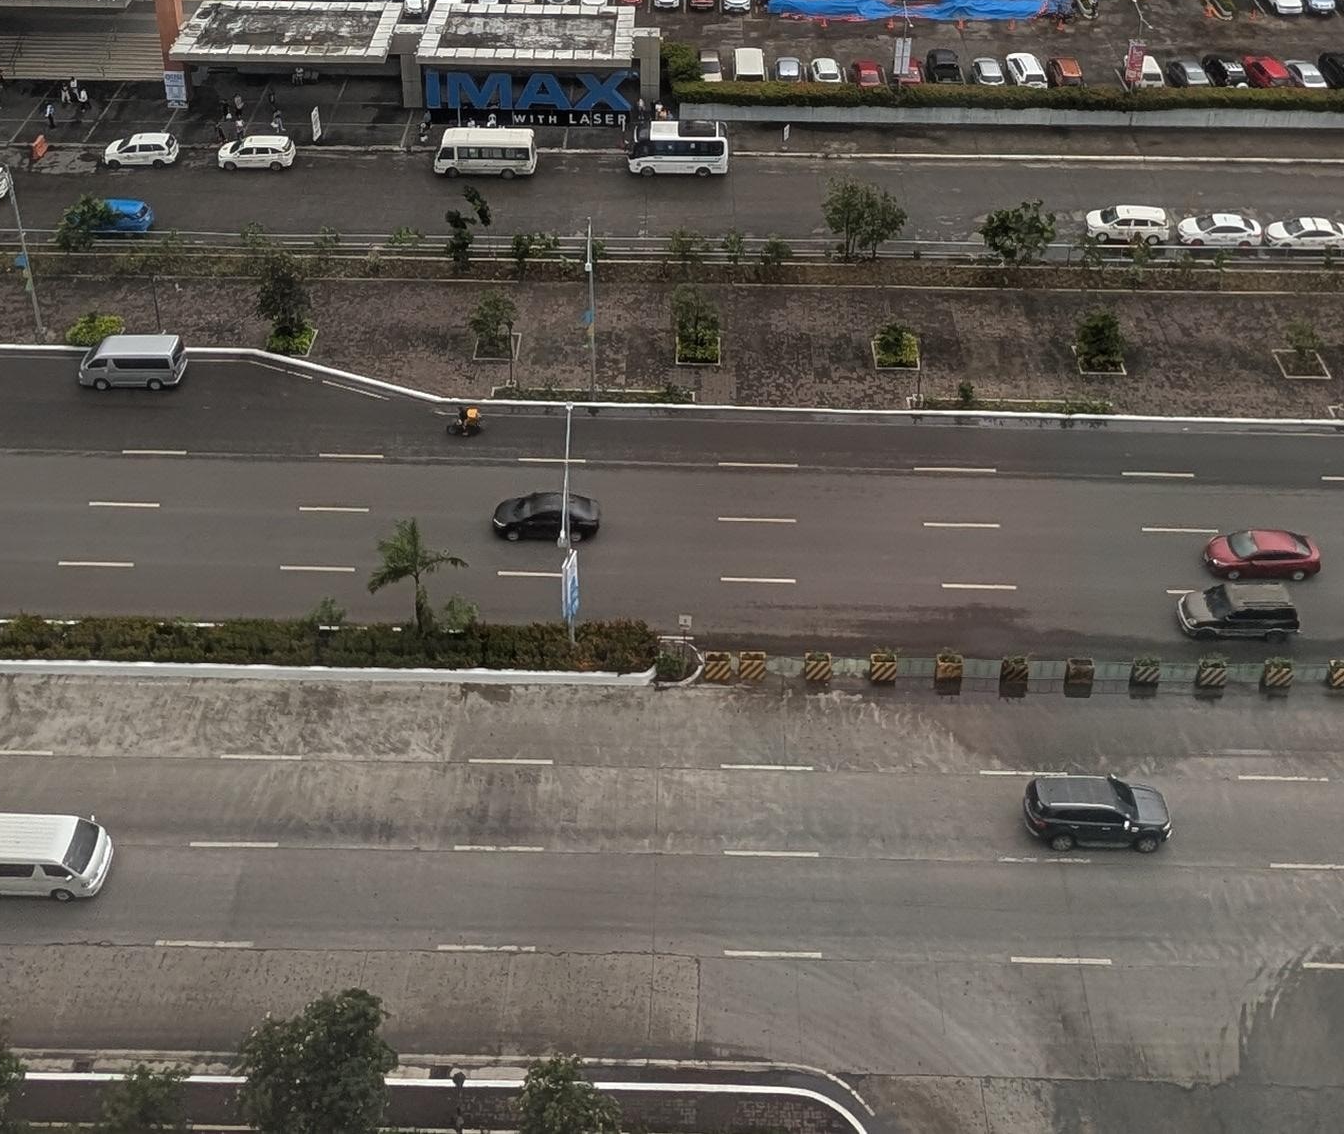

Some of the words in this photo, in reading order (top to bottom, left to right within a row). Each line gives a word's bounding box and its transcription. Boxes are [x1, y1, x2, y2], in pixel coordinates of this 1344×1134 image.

[425, 70, 632, 112] IMAX
[511, 114, 558, 126] WITH
[568, 113, 627, 126] LASER
